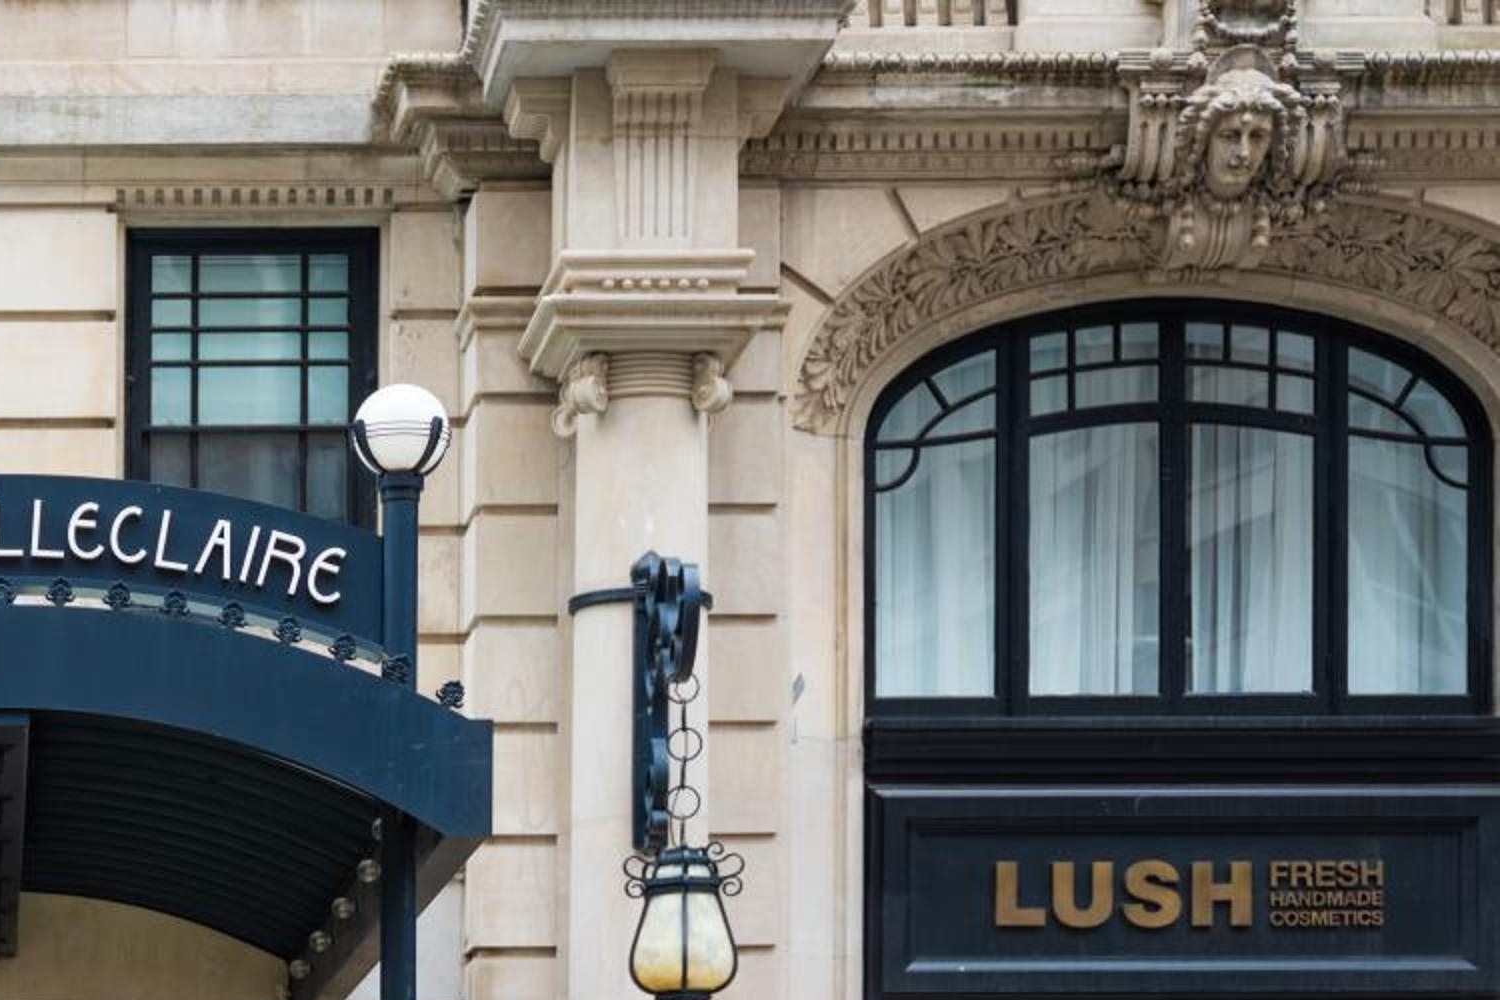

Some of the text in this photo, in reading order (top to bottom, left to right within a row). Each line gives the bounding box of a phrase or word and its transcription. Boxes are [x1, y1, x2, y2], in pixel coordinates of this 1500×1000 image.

[1268, 860, 1385, 888] FRESH
[994, 859, 1253, 929] LUSH
[1268, 890, 1385, 907] HANDMADE
[1268, 909, 1385, 927] COSMETICS
